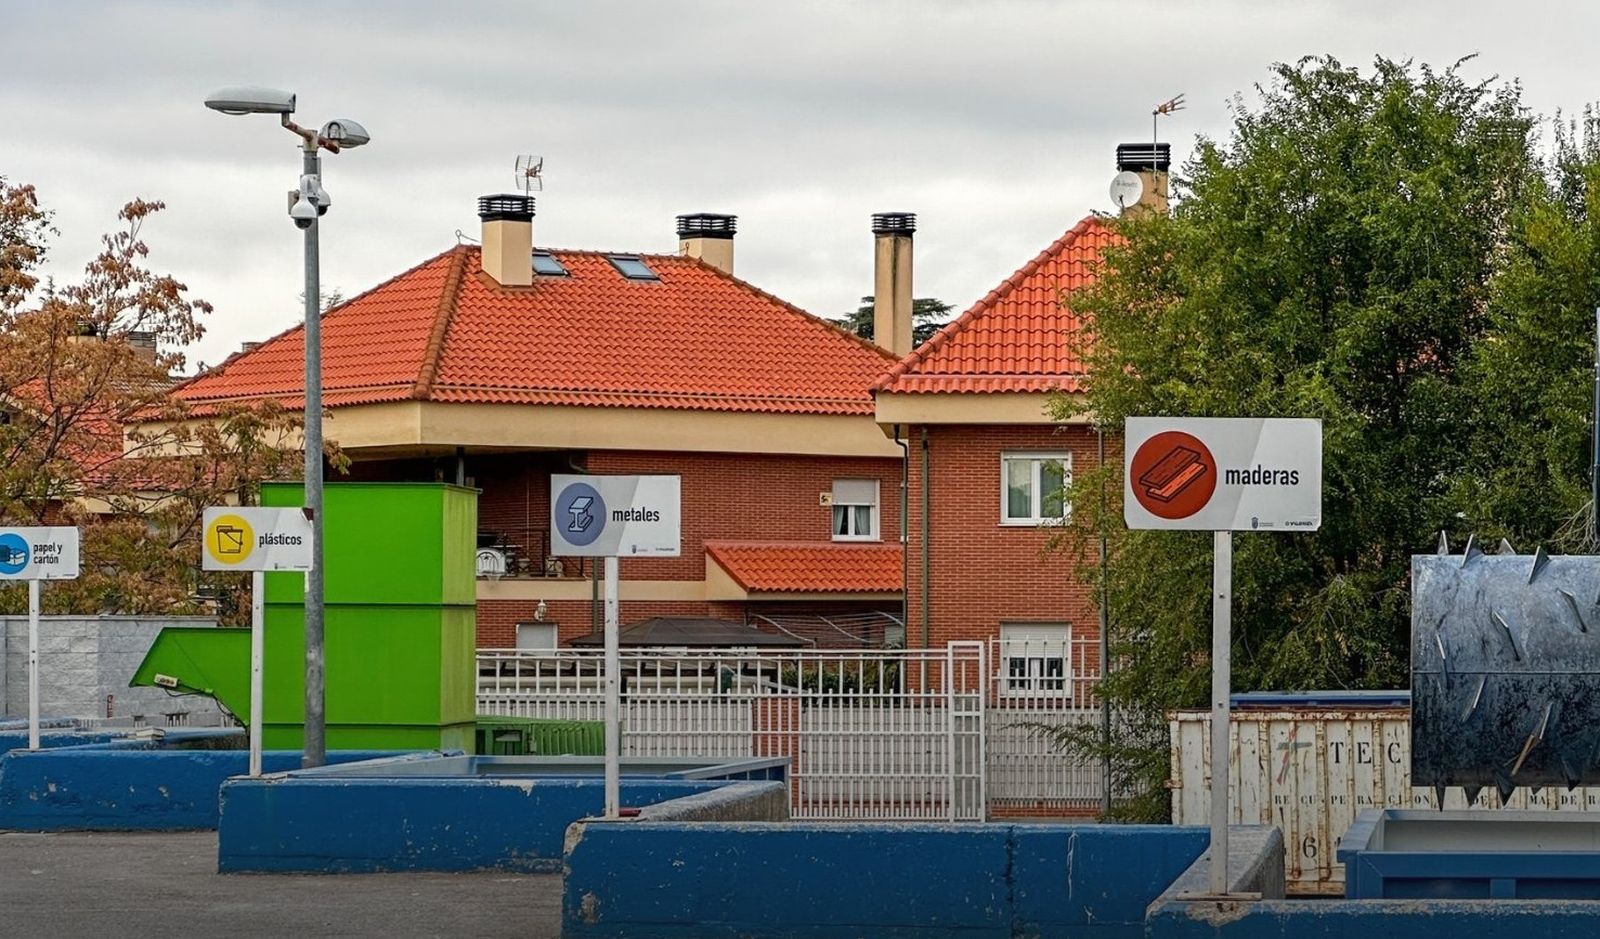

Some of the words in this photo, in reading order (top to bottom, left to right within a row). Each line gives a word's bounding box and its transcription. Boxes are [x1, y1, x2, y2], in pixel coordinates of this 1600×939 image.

[1225, 464, 1299, 485] maderas
[612, 506, 660, 522] metales
[33, 542, 56, 554] papel
[57, 544, 63, 554] y
[259, 533, 302, 548] plásticos
[33, 554, 59, 564] cartón
